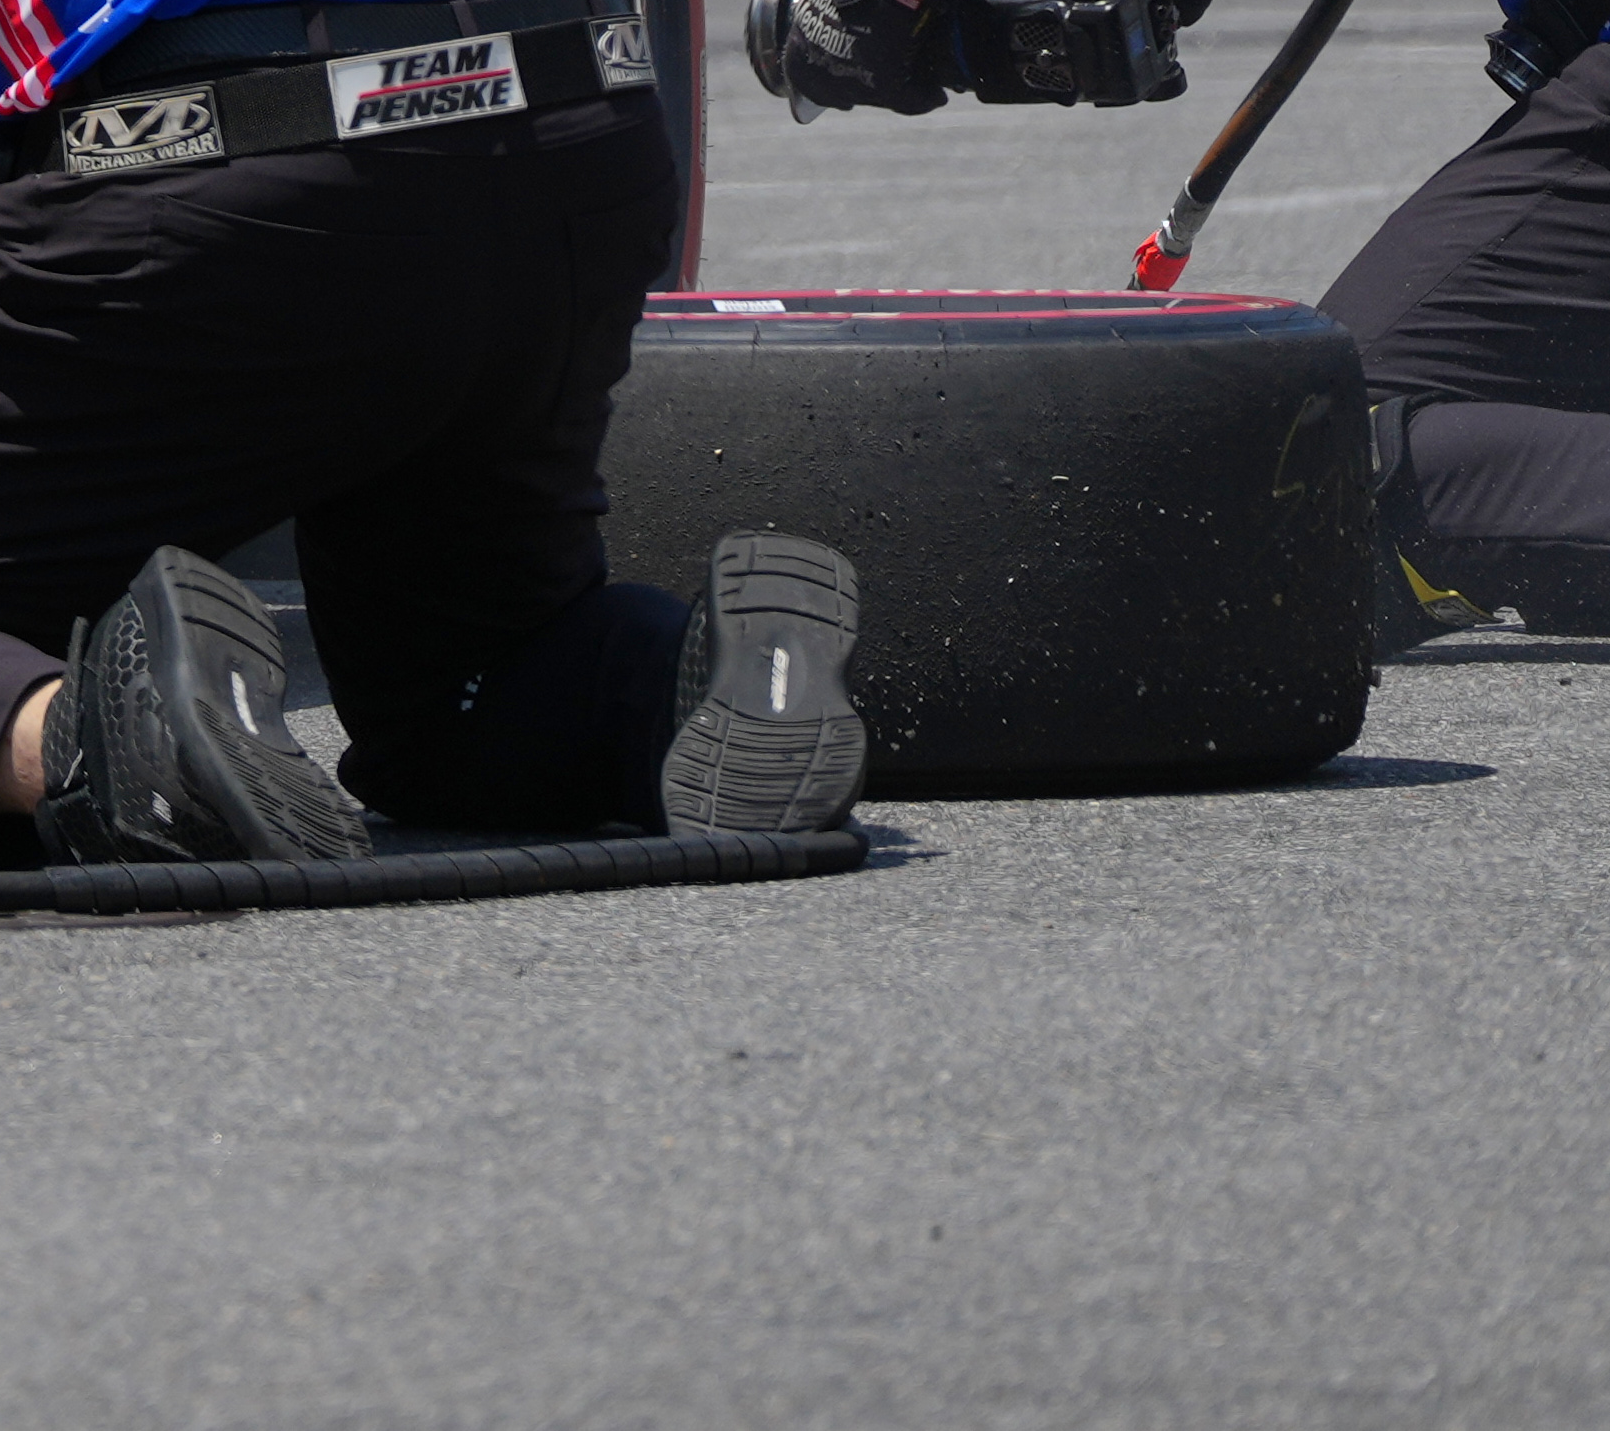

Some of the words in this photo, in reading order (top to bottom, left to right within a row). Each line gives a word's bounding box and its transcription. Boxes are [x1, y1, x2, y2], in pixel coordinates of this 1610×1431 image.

[378, 42, 492, 84] TEAM
[349, 78, 513, 129] PENSKE
[68, 149, 154, 174] MECHANIX
[156, 133, 218, 160] WEAR
